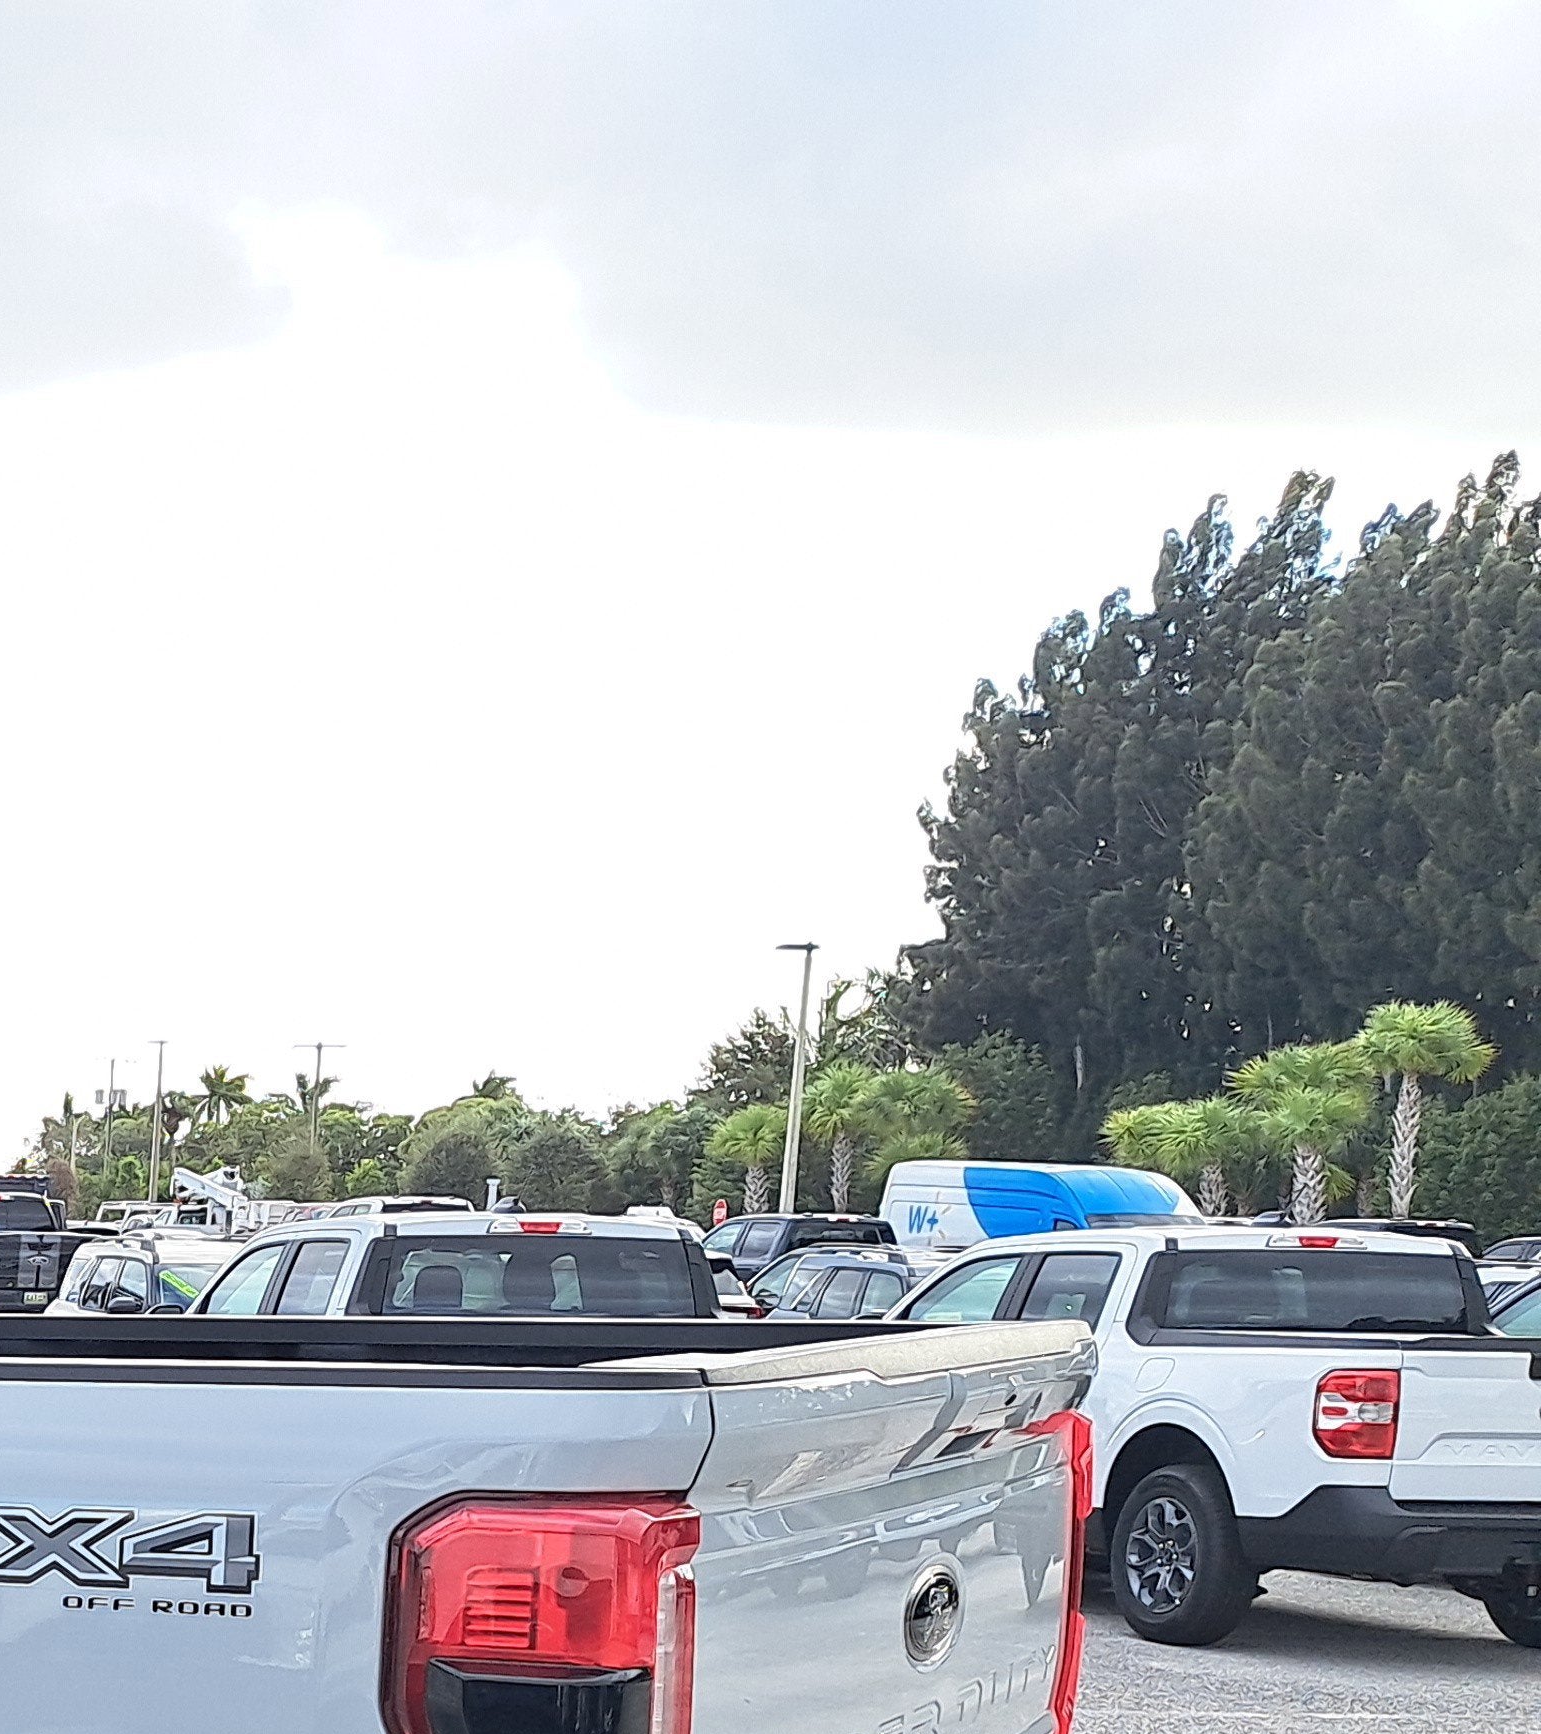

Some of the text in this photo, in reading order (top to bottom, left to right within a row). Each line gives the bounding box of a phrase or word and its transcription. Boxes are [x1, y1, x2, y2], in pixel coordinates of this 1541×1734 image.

[908, 1204, 939, 1234] W+
[61, 1594, 254, 1619] OFF ROAD
[959, 1645, 1056, 1722] DUTY
